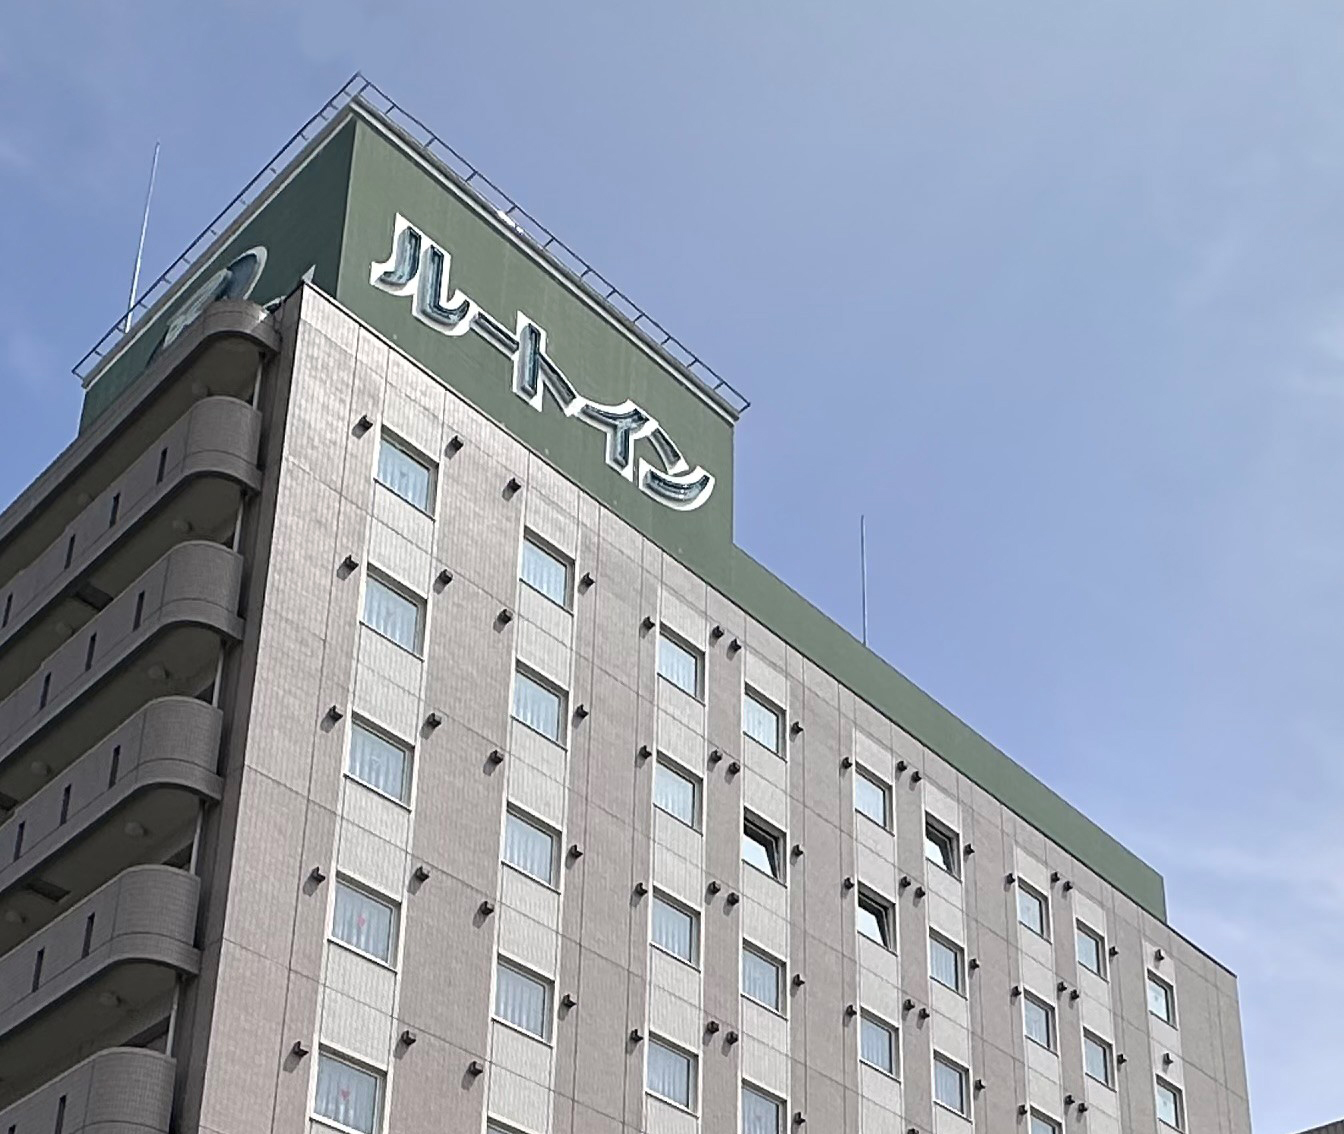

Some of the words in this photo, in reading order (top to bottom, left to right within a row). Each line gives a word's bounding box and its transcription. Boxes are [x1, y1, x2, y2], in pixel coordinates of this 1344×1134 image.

[370, 213, 715, 511] ルートイン
